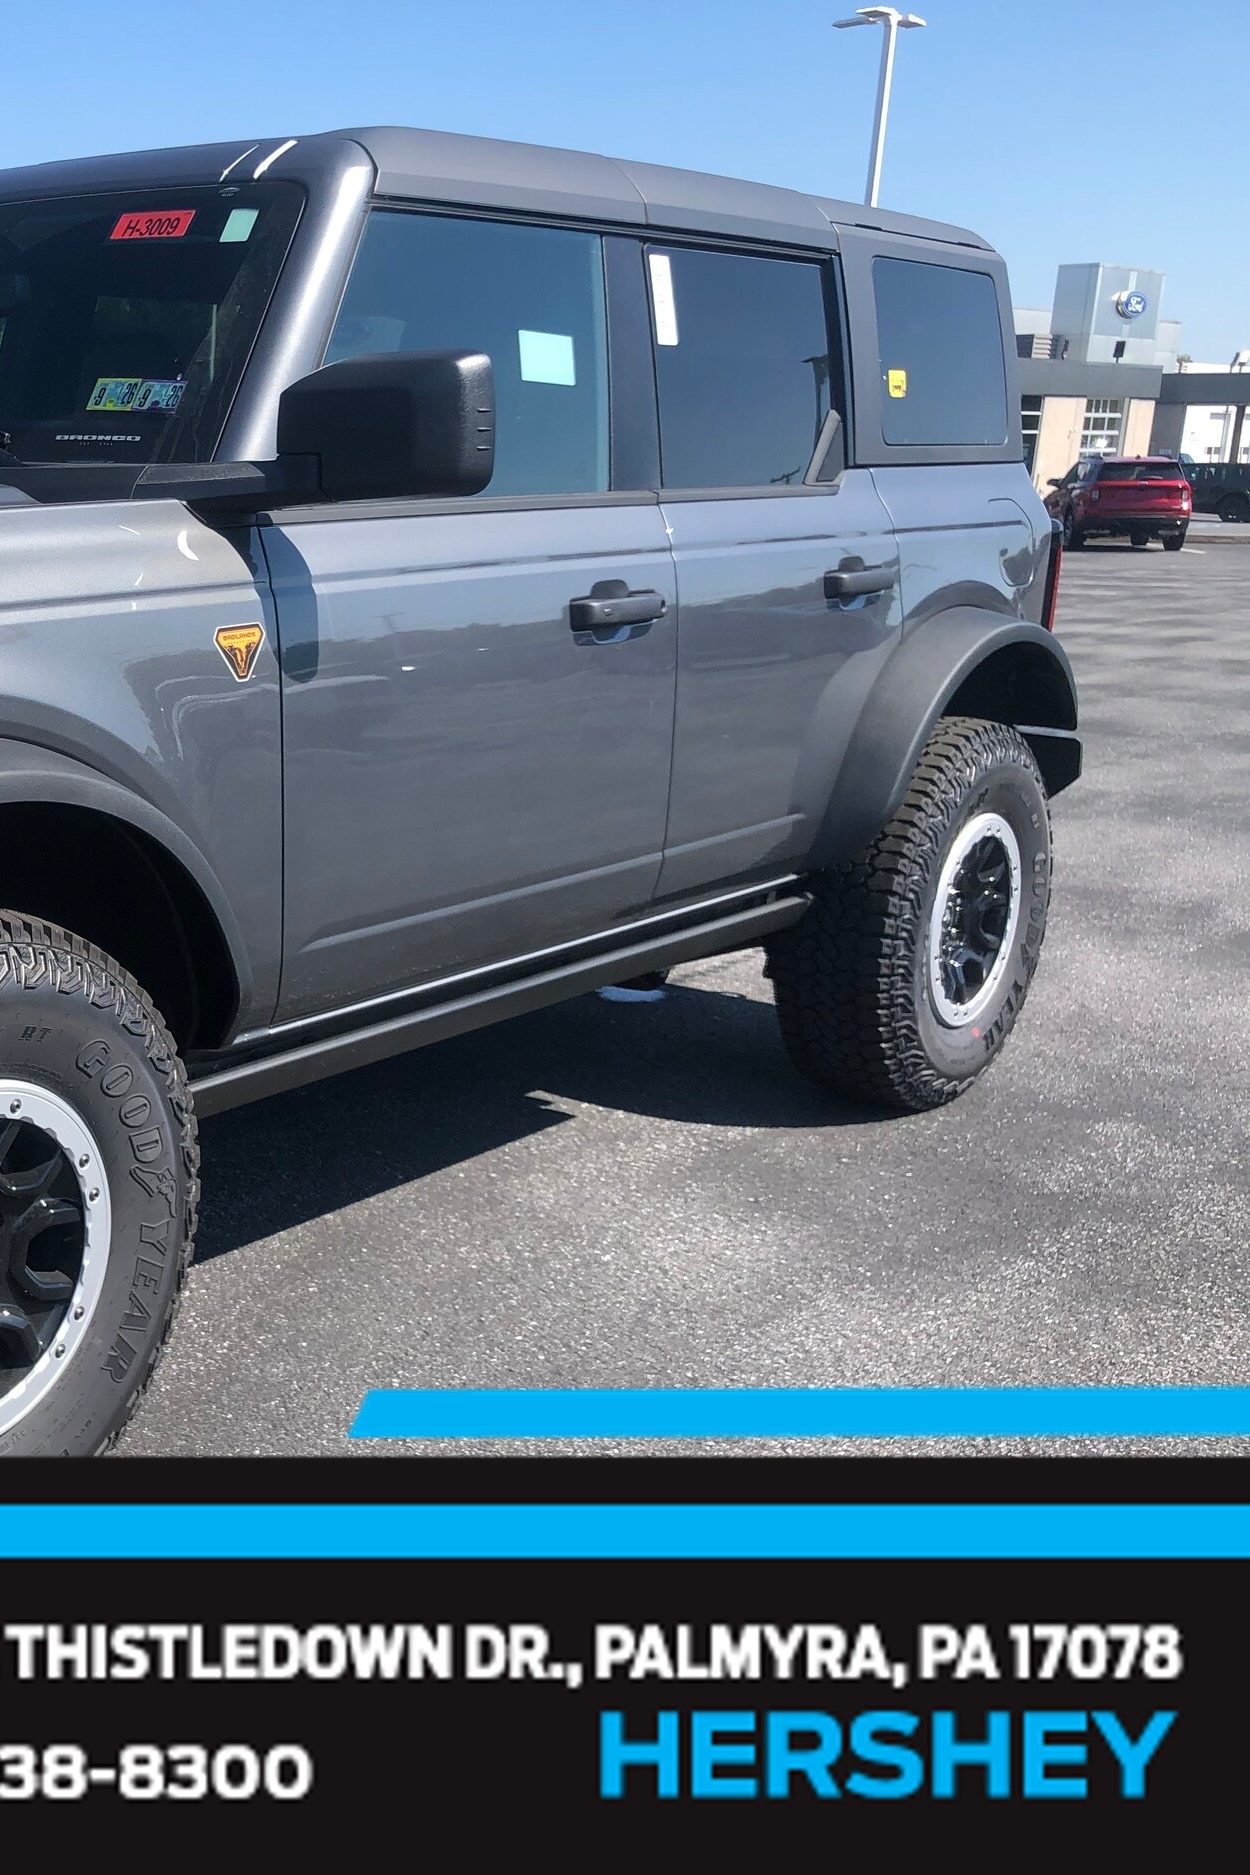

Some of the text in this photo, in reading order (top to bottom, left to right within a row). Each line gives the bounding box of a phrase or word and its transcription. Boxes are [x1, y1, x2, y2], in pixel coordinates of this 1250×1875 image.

[121, 217, 181, 237] H-3009
[55, 434, 141, 442] BRONCO
[18, 1025, 53, 1043] RT
